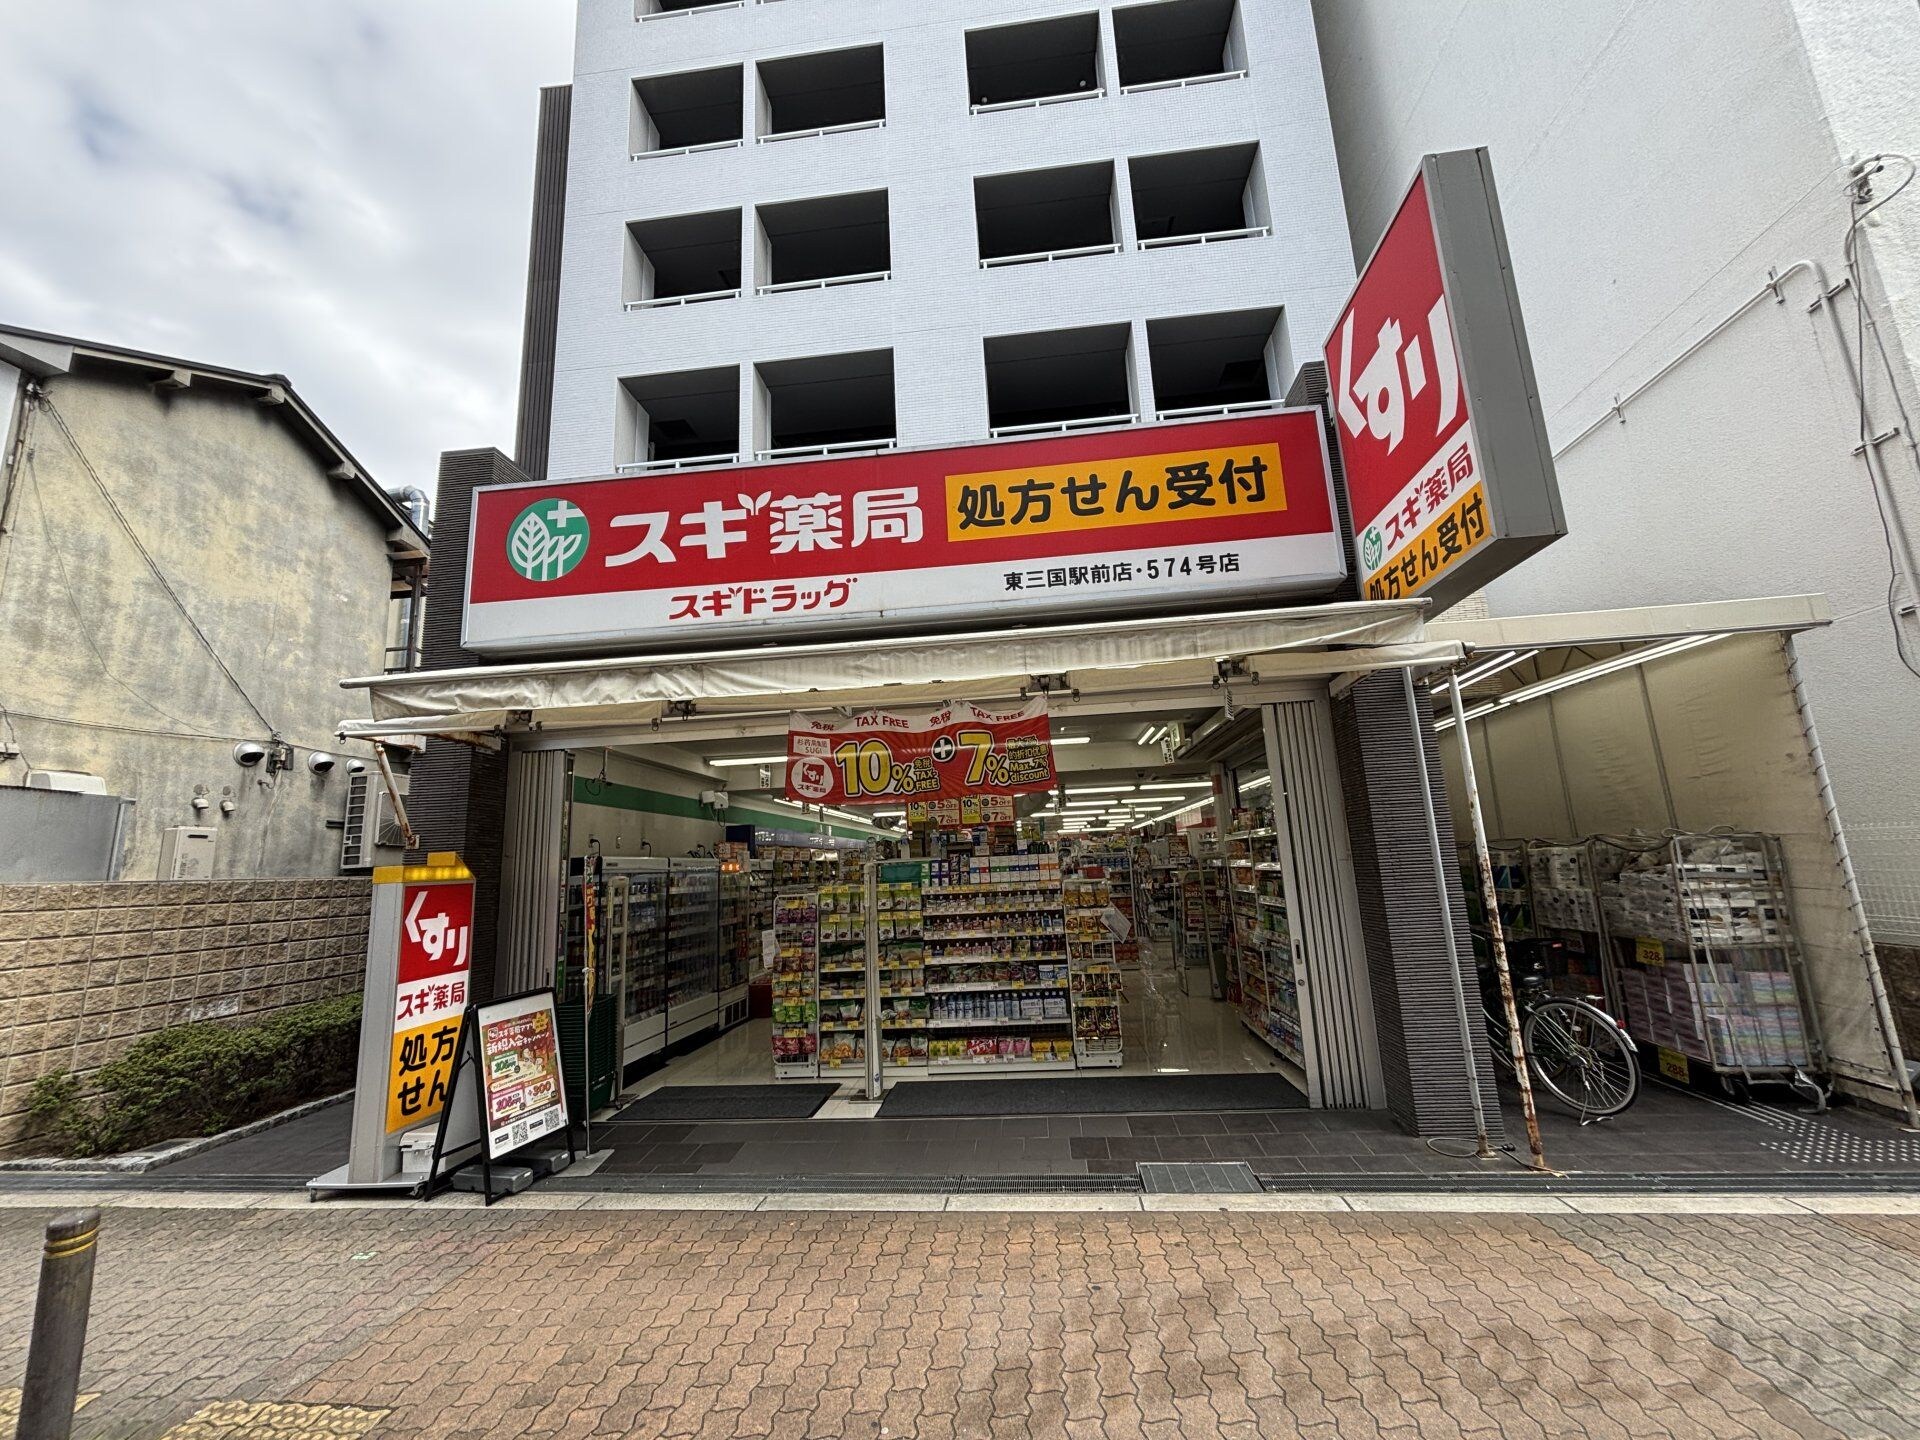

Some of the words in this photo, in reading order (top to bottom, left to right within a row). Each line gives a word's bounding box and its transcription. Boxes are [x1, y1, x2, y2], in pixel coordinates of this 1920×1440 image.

[1338, 293, 1459, 456] くすり
[957, 455, 1269, 531] 処方せん受付
[1385, 441, 1474, 551] スギ薬局
[605, 486, 924, 568] スギ薬局
[668, 577, 858, 620] スギドラッグ
[854, 715, 879, 728] TAX
[882, 715, 910, 729] FREE
[969, 706, 993, 721] TAX
[996, 711, 1025, 722] FREE
[805, 746, 823, 754] SUGI
[835, 739, 914, 796] 10%
[959, 732, 1009, 784] 7%
[1009, 762, 1032, 772] Max.
[1032, 758, 1047, 769] 7%
[915, 780, 939, 791] FREE
[1010, 770, 1049, 783] discount
[404, 890, 469, 967] くすり
[397, 981, 465, 1021] スギ薬局
[399, 1025, 458, 1076] 処方
[397, 1069, 448, 1116] せん
